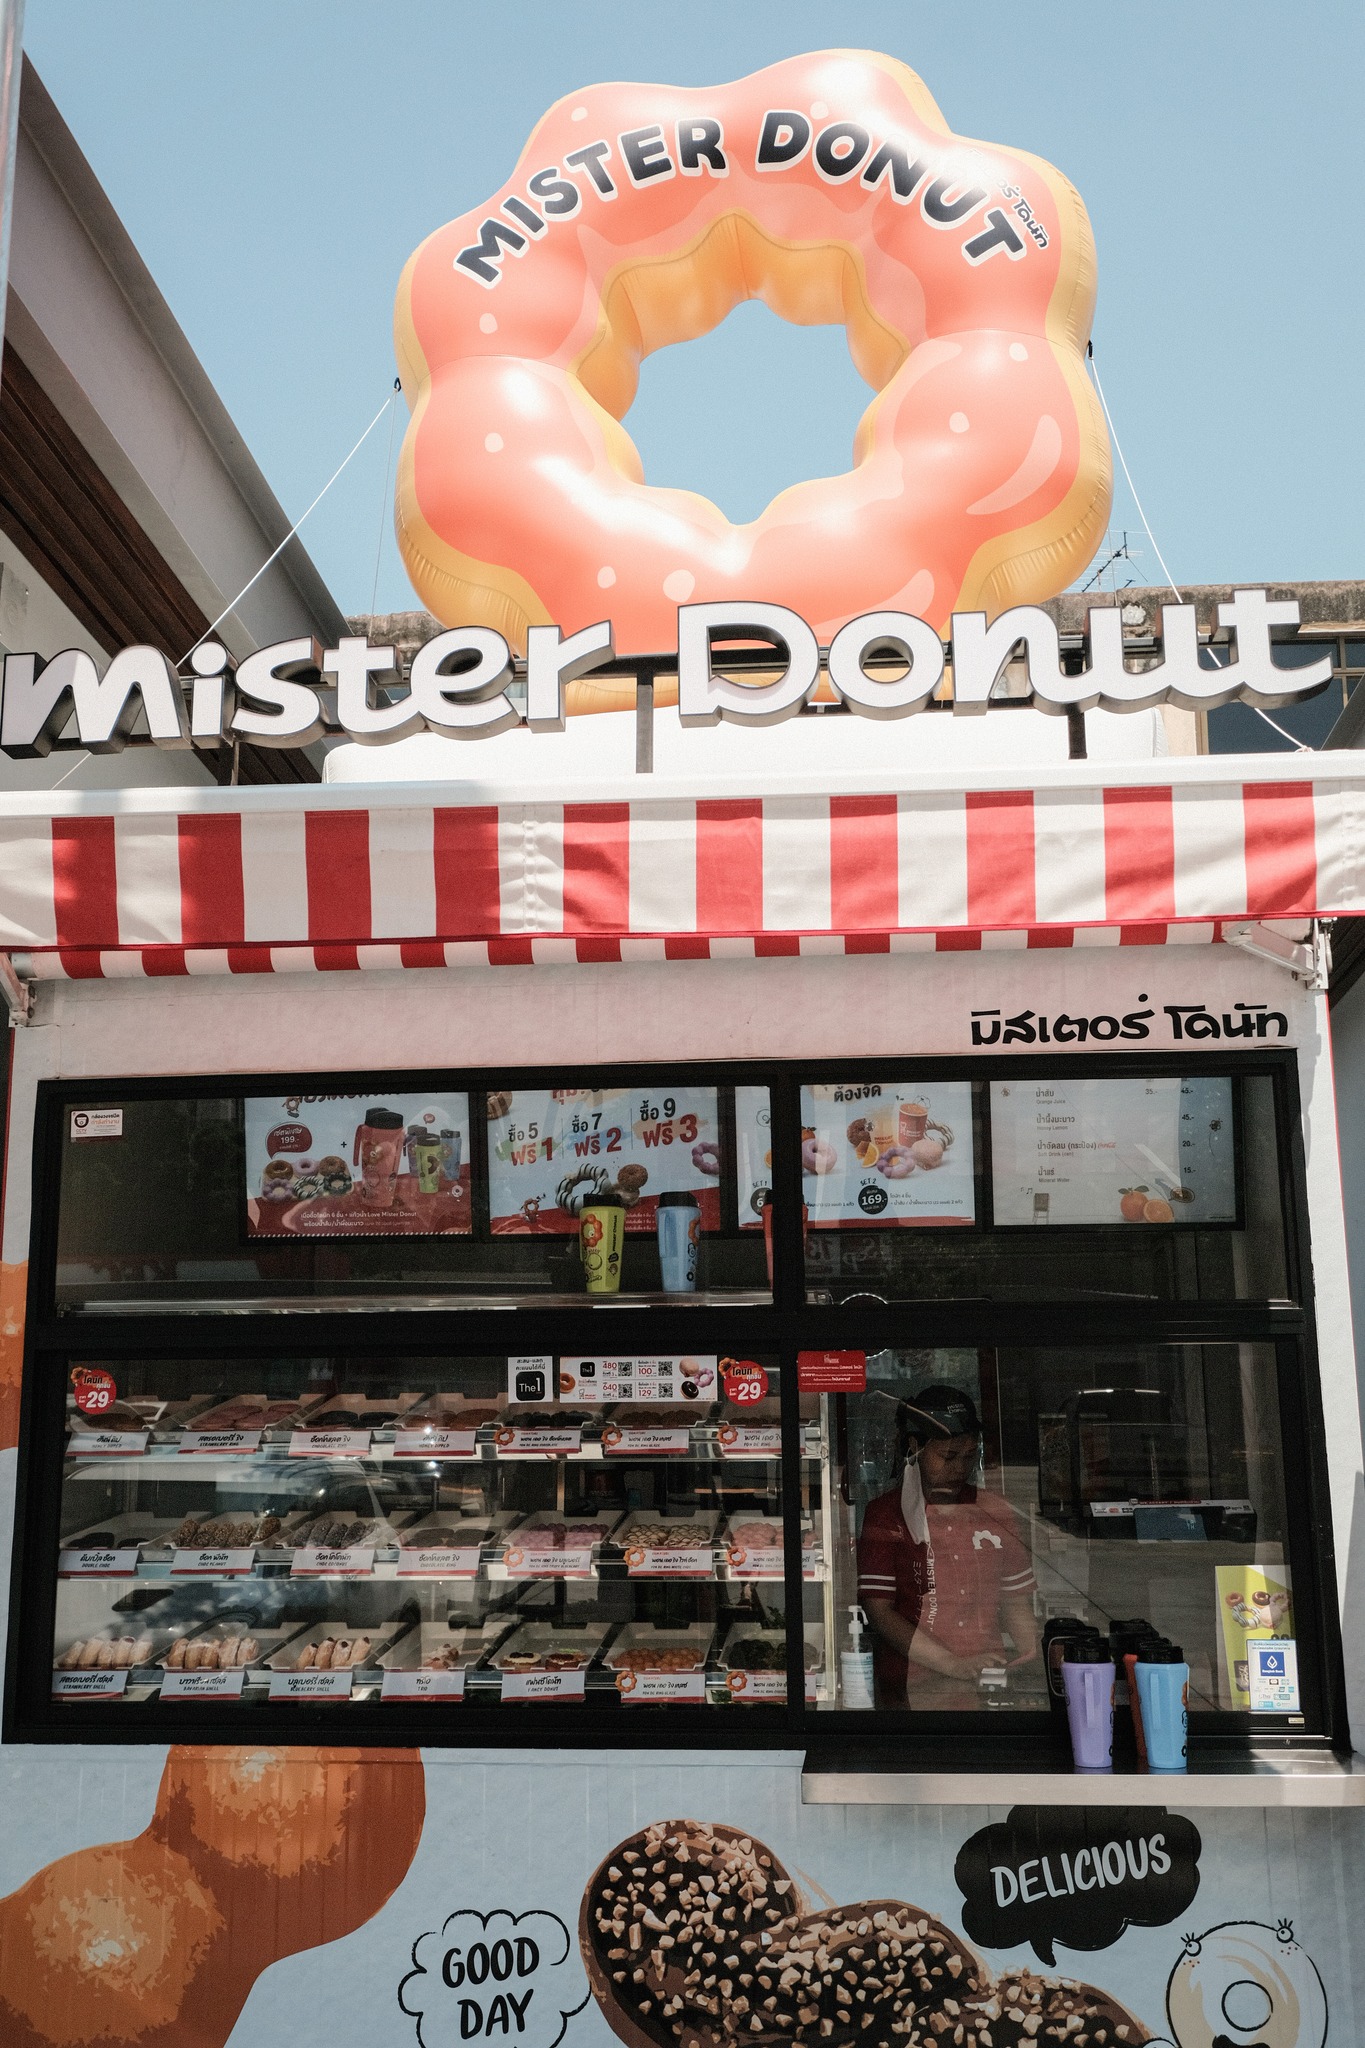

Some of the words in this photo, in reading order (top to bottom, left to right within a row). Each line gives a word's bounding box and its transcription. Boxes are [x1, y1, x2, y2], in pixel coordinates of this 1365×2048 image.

[455, 117, 727, 289] MISTER
[757, 111, 1027, 264] DONUT
[678, 588, 1333, 726] Donut
[972, 994, 1156, 1046] มิสเตอร์
[1164, 1002, 1288, 1040] โดนัท
[572, 1115, 588, 1133] ซื้อ
[592, 1113, 602, 1130] 7
[640, 1100, 659, 1121] ซื้อ
[663, 1098, 676, 1118] 9
[508, 1124, 524, 1142] ซื้อ
[528, 1122, 538, 1139] 5
[574, 1134, 600, 1157] ฟรี
[606, 1127, 622, 1153] 2
[642, 1120, 674, 1148] ฟรี
[680, 1114, 698, 1143] 3
[510, 1144, 536, 1166] ฟรี
[542, 1137, 552, 1161] 1
[926, 1558, 936, 1594] MISTER
[927, 1597, 938, 1625] DONUT
[990, 1833, 1172, 1908] DELICIOUS
[442, 1937, 540, 1988] GOOD
[457, 1989, 534, 2040] DAY
